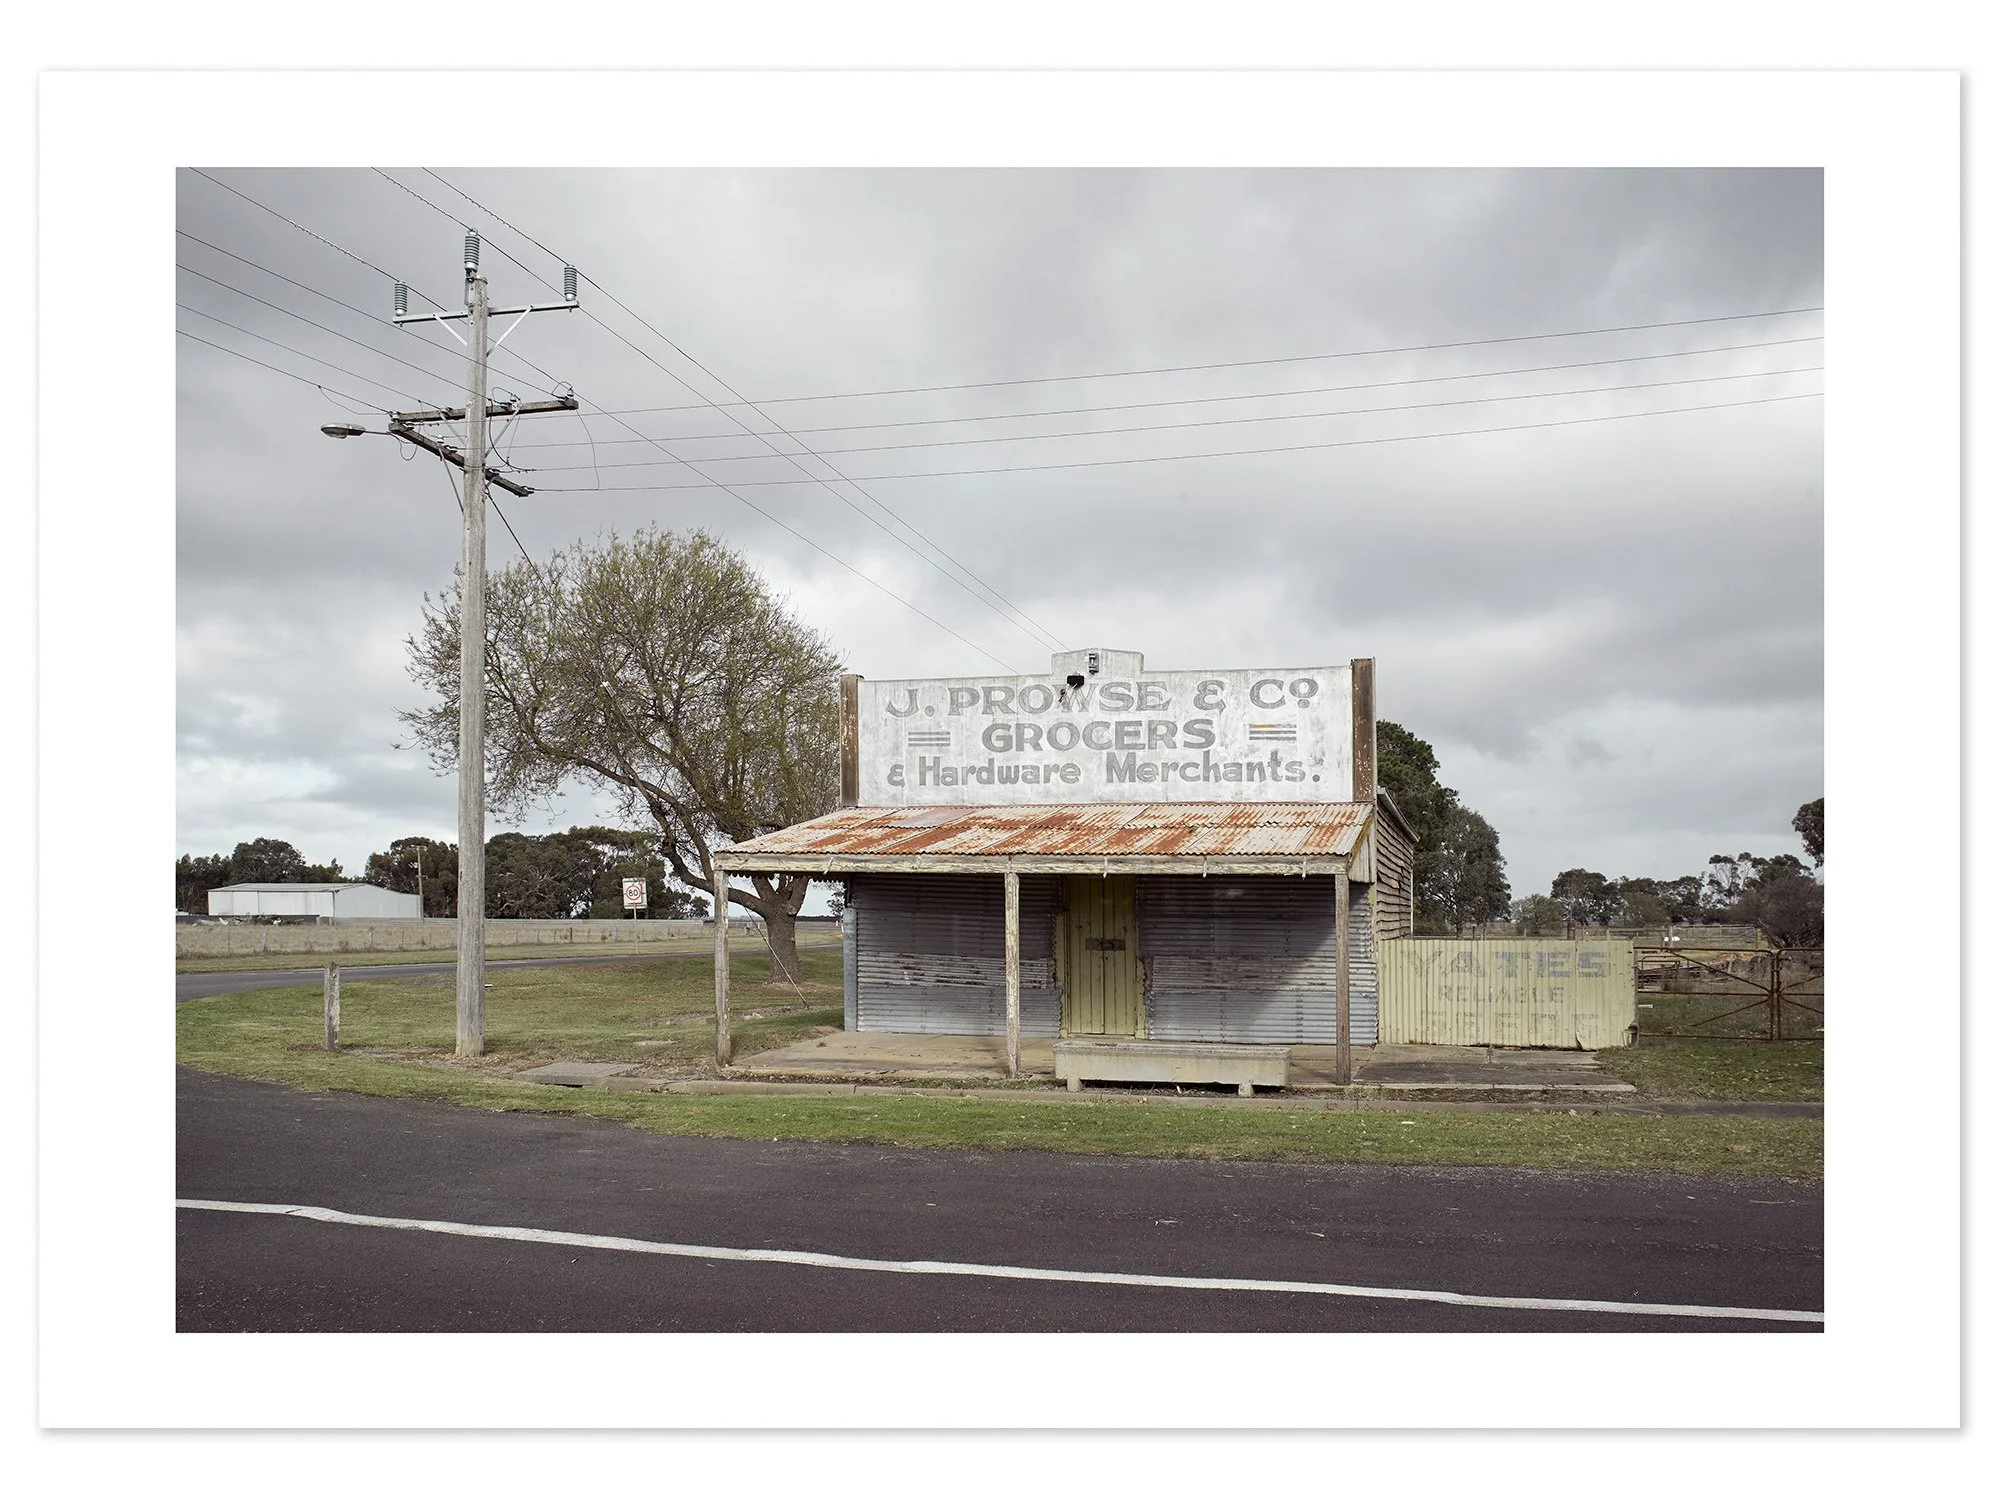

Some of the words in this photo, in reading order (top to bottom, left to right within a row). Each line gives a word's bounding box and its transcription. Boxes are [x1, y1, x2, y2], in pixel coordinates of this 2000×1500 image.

[885, 688, 935, 718] J.
[948, 679, 1173, 717] PROWSE
[1194, 679, 1227, 715] &
[982, 718, 1216, 752] GROCERS
[887, 763, 906, 787] &
[918, 756, 1081, 787] Hardware
[628, 889, 639, 897] 80
